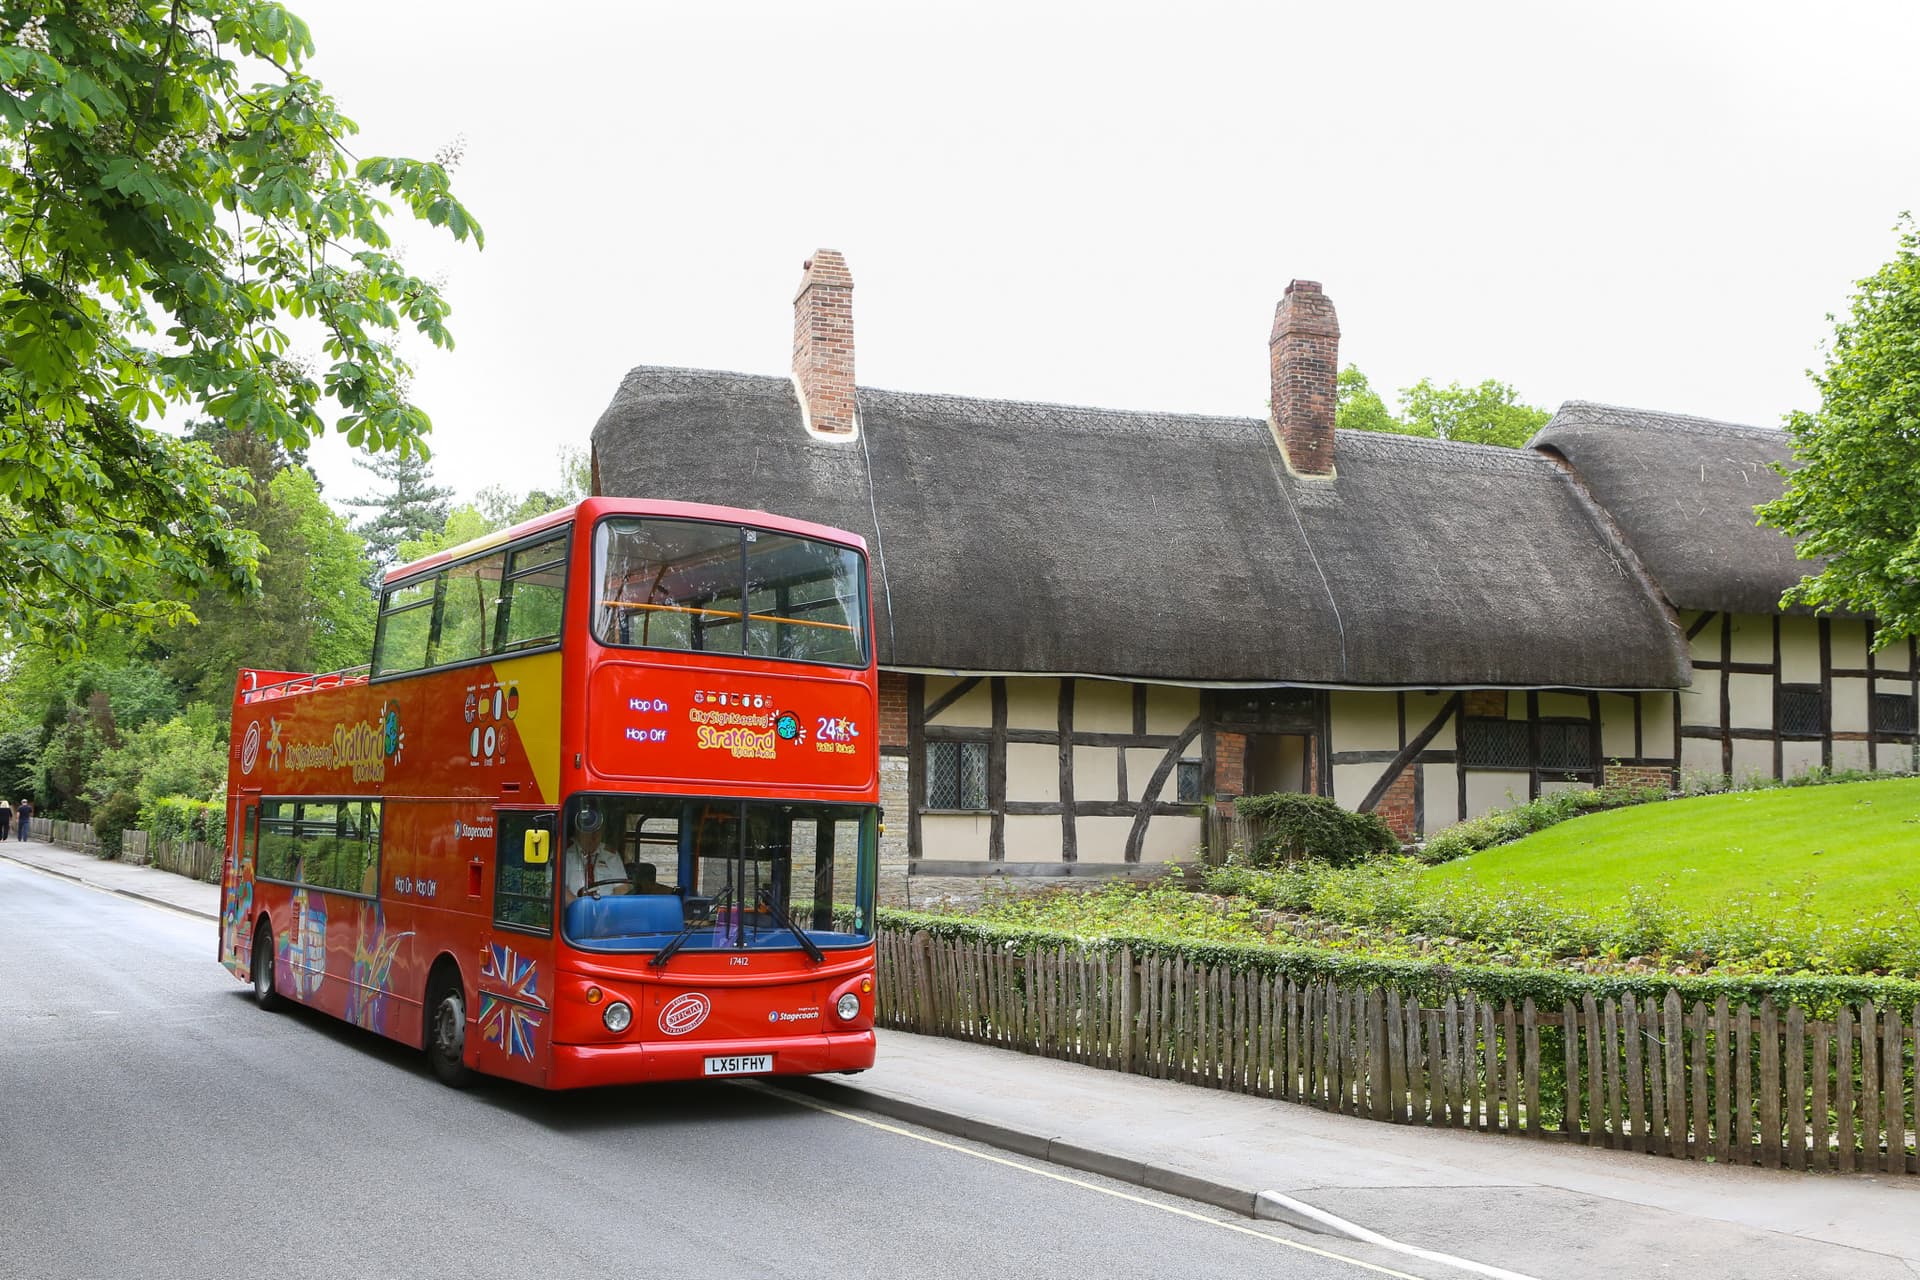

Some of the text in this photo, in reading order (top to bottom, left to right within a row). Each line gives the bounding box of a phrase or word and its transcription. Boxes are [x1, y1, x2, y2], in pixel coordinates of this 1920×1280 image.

[629, 698, 668, 712] Hop On
[626, 728, 667, 742] Hop Off
[816, 717, 836, 740] 24
[333, 719, 386, 769] Stratford
[698, 726, 775, 750] Stratford
[462, 823, 494, 841] Stagecoach
[395, 875, 437, 897] Hop On Hop Off
[729, 957, 749, 966] 17412
[667, 1001, 702, 1025] OFFICIAL
[780, 1011, 819, 1022] Stagecoach
[712, 1056, 766, 1072] LX51 FHY
